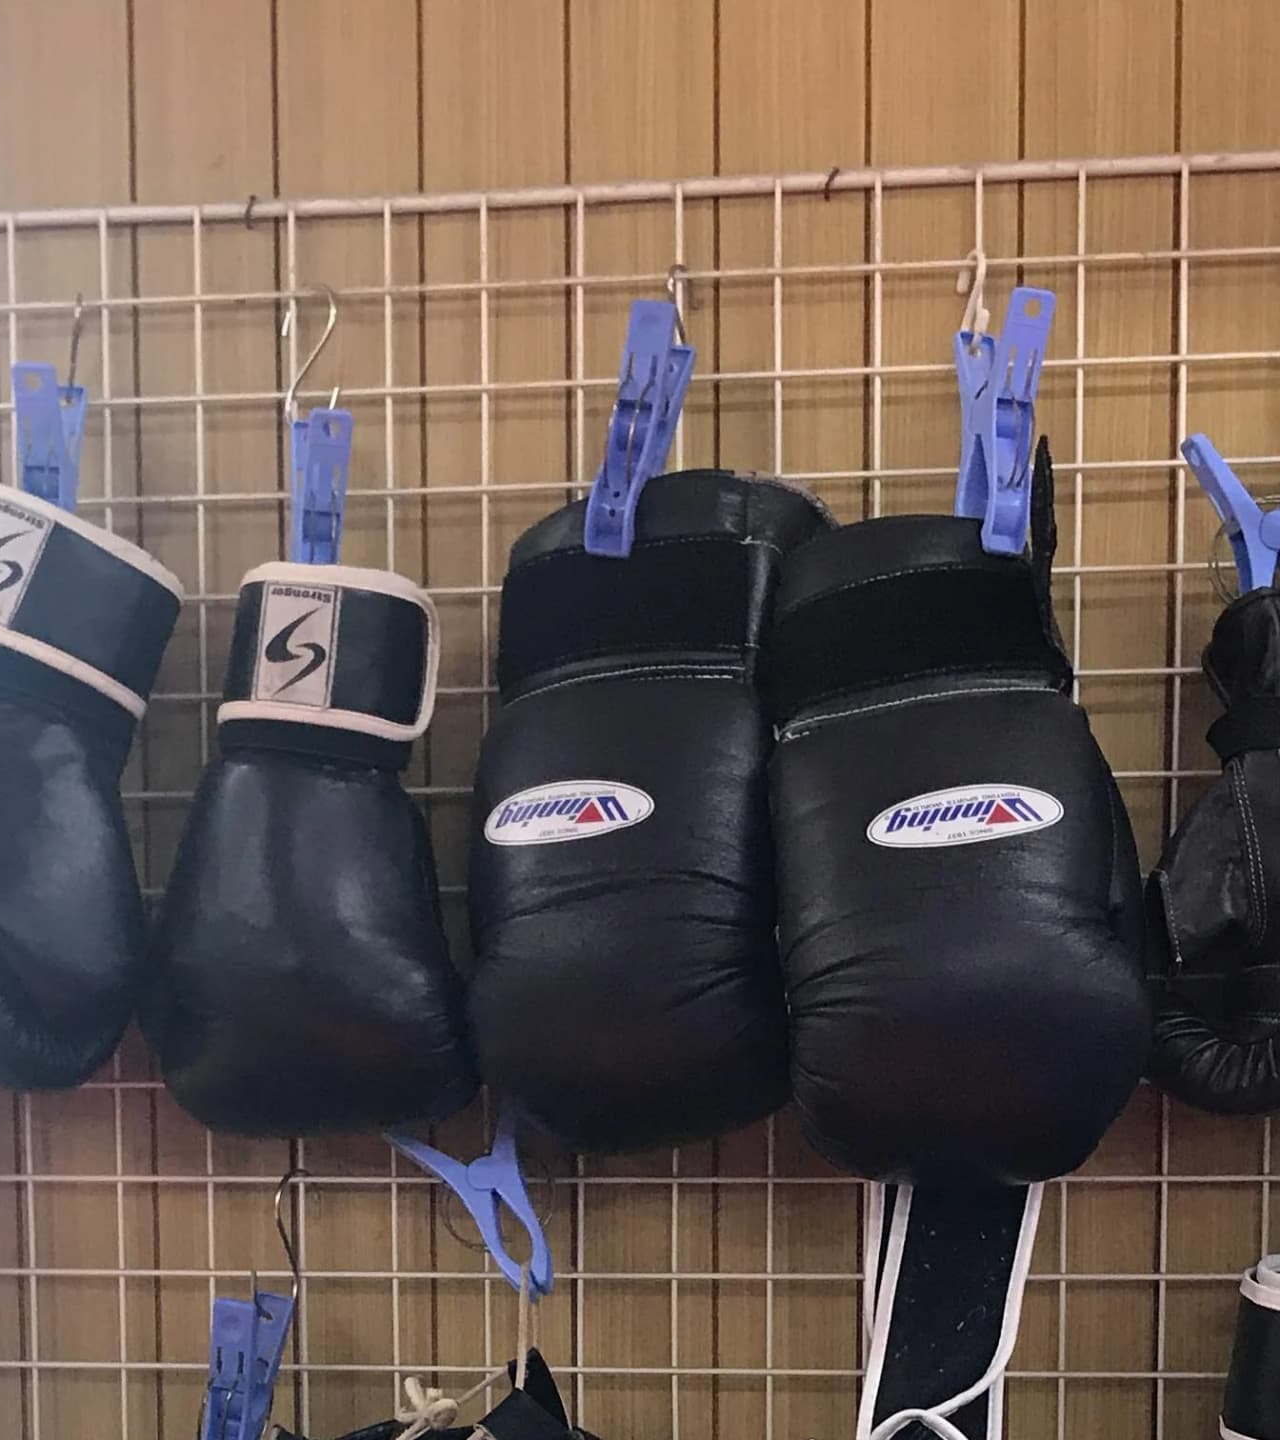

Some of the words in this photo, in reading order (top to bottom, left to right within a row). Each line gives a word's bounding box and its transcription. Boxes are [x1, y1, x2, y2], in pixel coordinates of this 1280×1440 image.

[271, 586, 332, 604] Stronger
[494, 795, 630, 830] Winning
[885, 798, 1044, 834] Winning
[946, 831, 968, 840] 1937
[969, 827, 994, 836] SINCE
